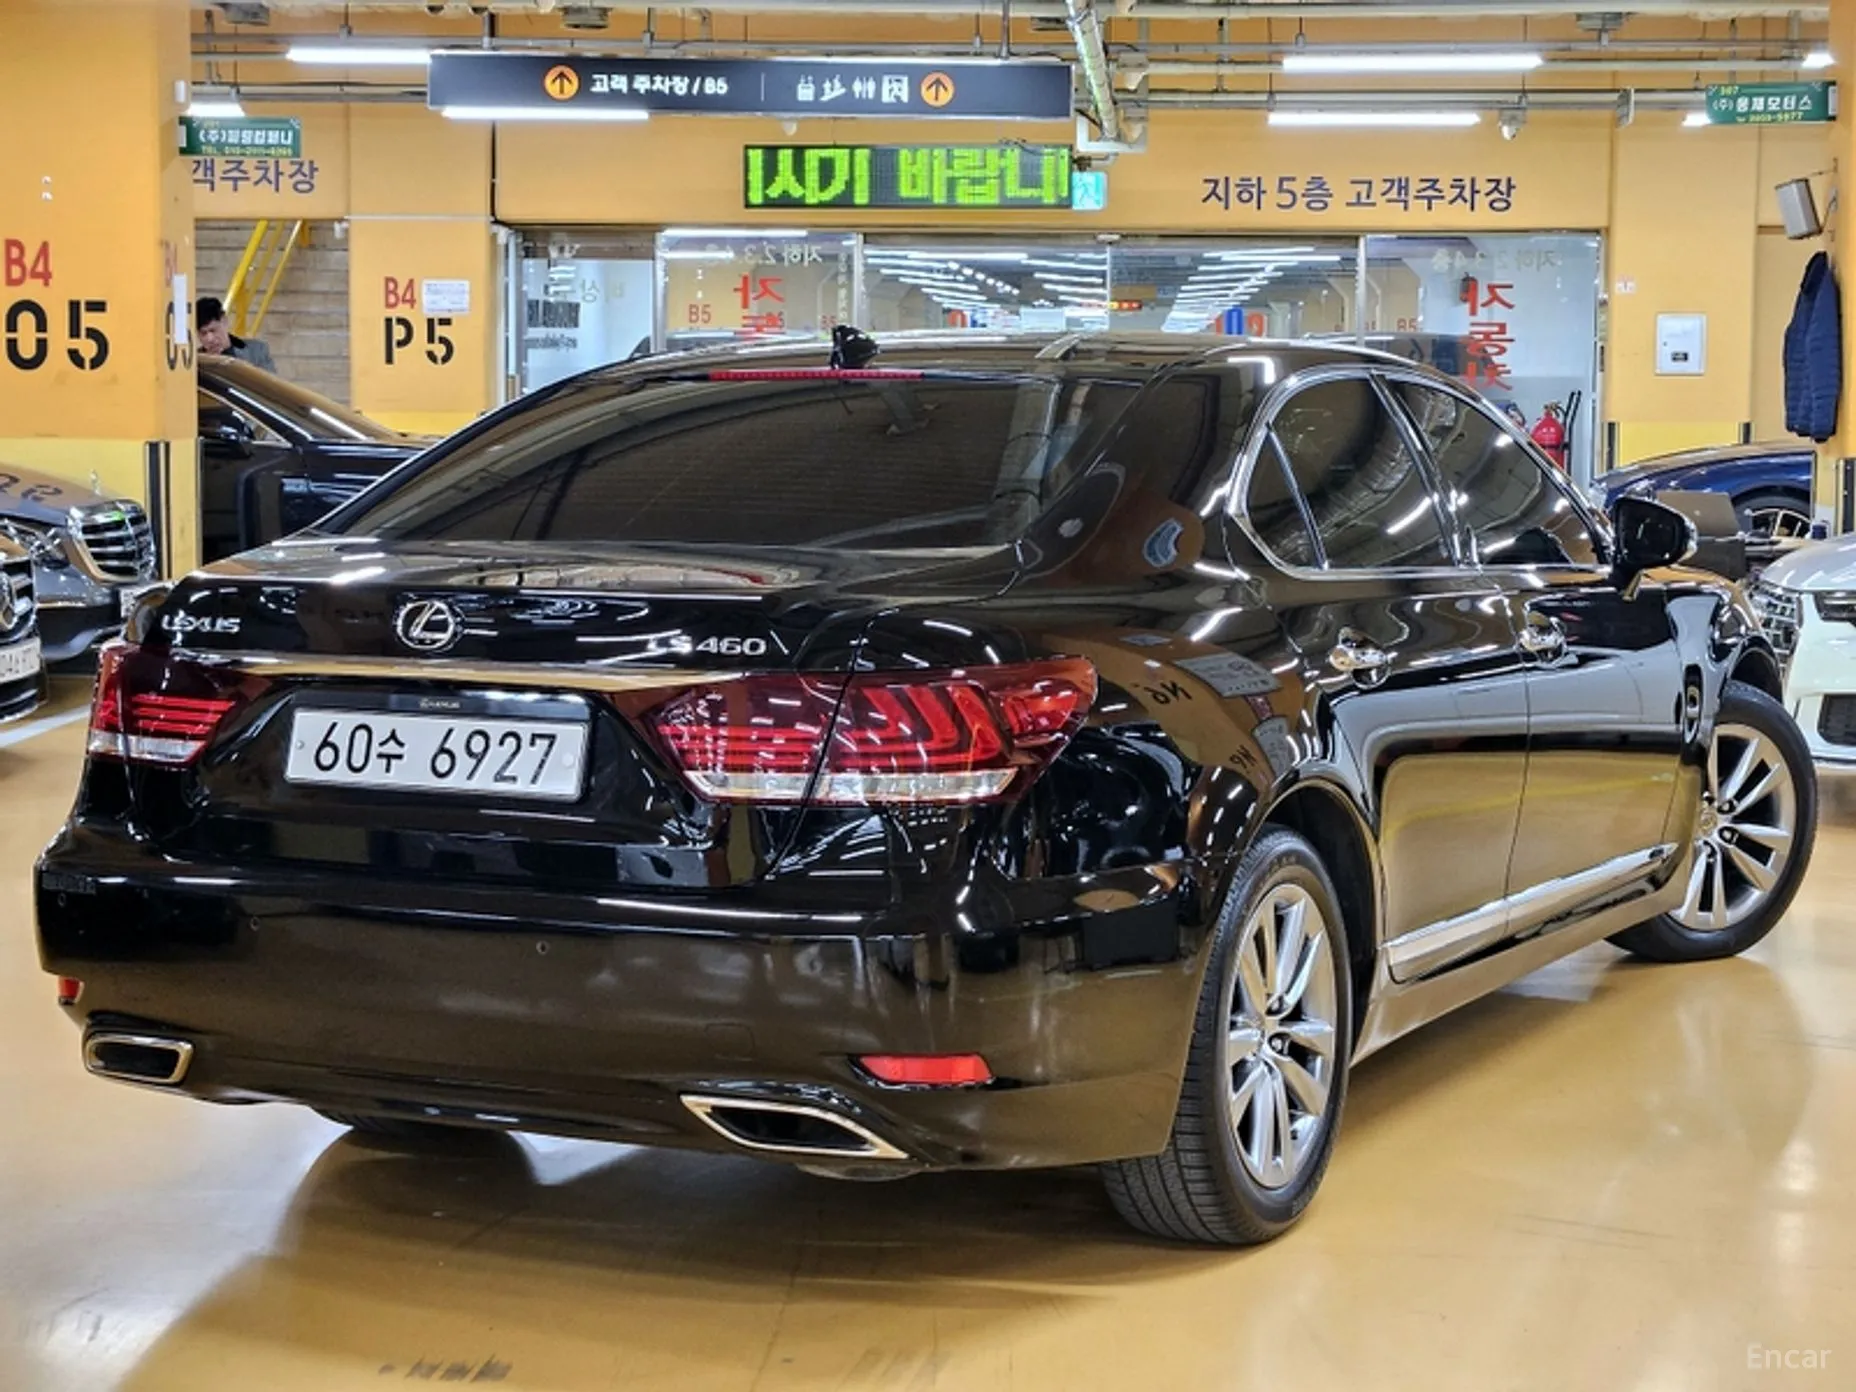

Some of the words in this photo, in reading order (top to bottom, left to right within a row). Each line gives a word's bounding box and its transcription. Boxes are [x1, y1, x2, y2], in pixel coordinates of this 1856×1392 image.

[590, 74, 628, 94] 고객
[633, 73, 690, 96] 주차장
[747, 147, 871, 205] 시기
[898, 147, 1069, 205] 바랍니
[1201, 175, 1266, 211] 지하
[1275, 175, 1334, 211] 5층
[1345, 175, 1517, 212] 고객주차장
[4, 238, 53, 288] B4
[384, 276, 417, 310] B4
[161, 614, 241, 634] LEXUS
[695, 635, 767, 656] 460
[314, 721, 406, 774] 60수
[430, 727, 558, 785] 6927
